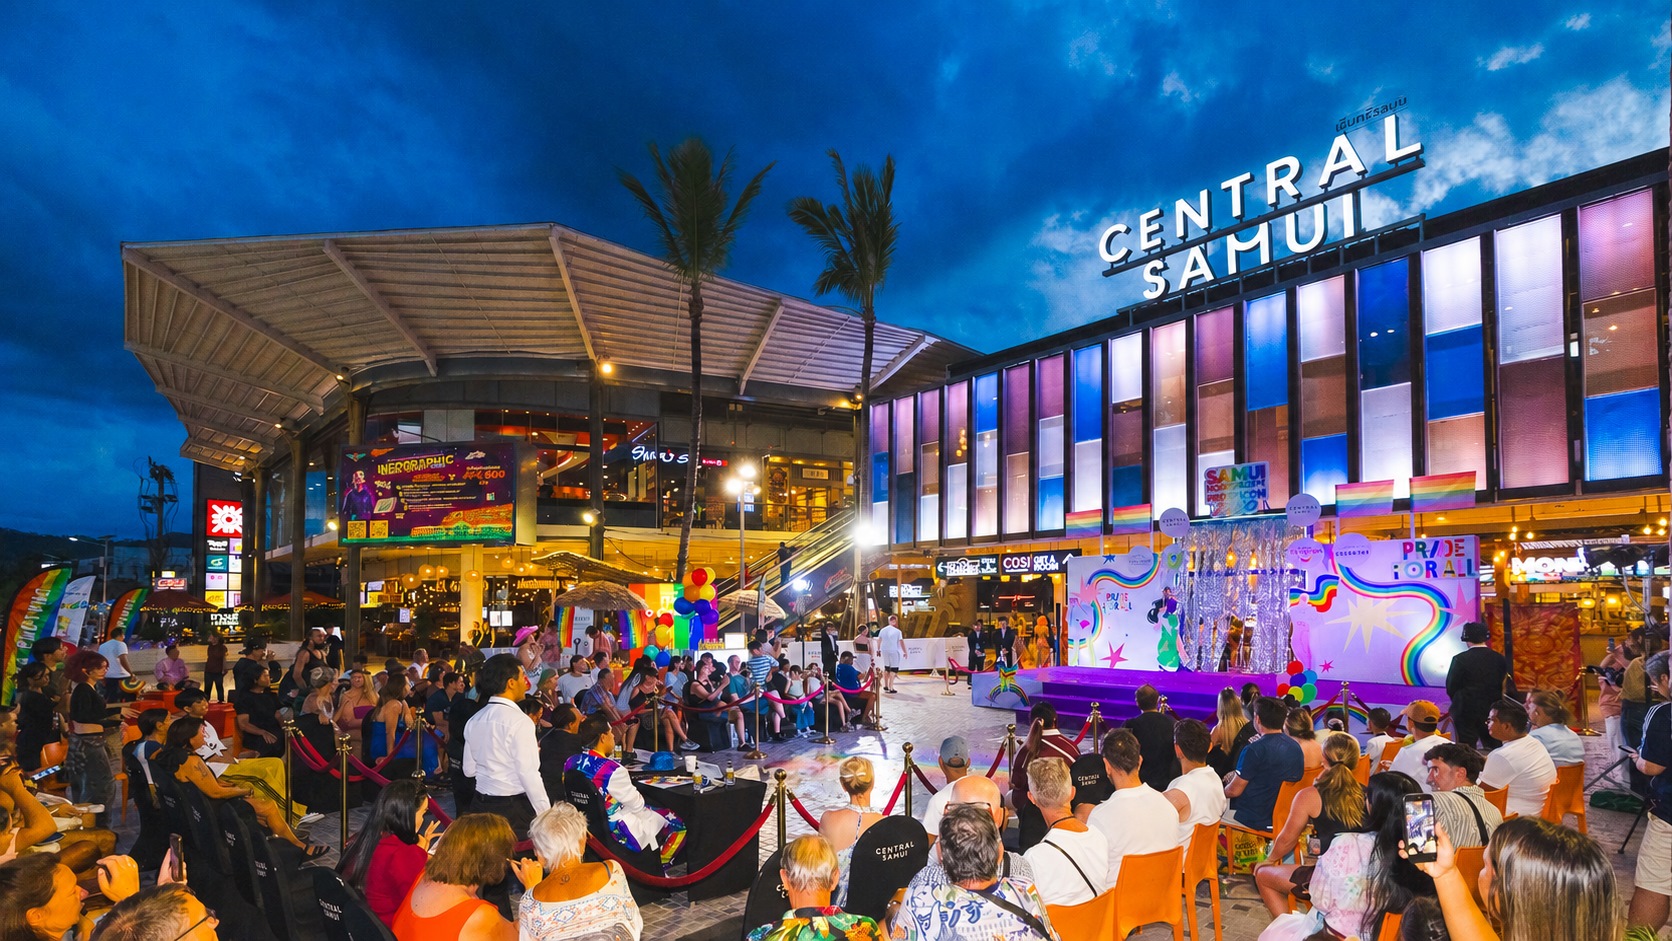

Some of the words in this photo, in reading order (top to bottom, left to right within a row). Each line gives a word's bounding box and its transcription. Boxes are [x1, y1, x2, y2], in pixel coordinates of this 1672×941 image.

[1098, 113, 1424, 265] CENTRAL
[1142, 193, 1357, 300] SAMUI
[1206, 464, 1266, 485] SAMUI
[1402, 538, 1466, 561] PRIDE
[1003, 556, 1031, 569] COSI
[1442, 558, 1477, 578] ALL
[875, 841, 915, 855] CENTRAL
[882, 850, 908, 861] SAMUI
